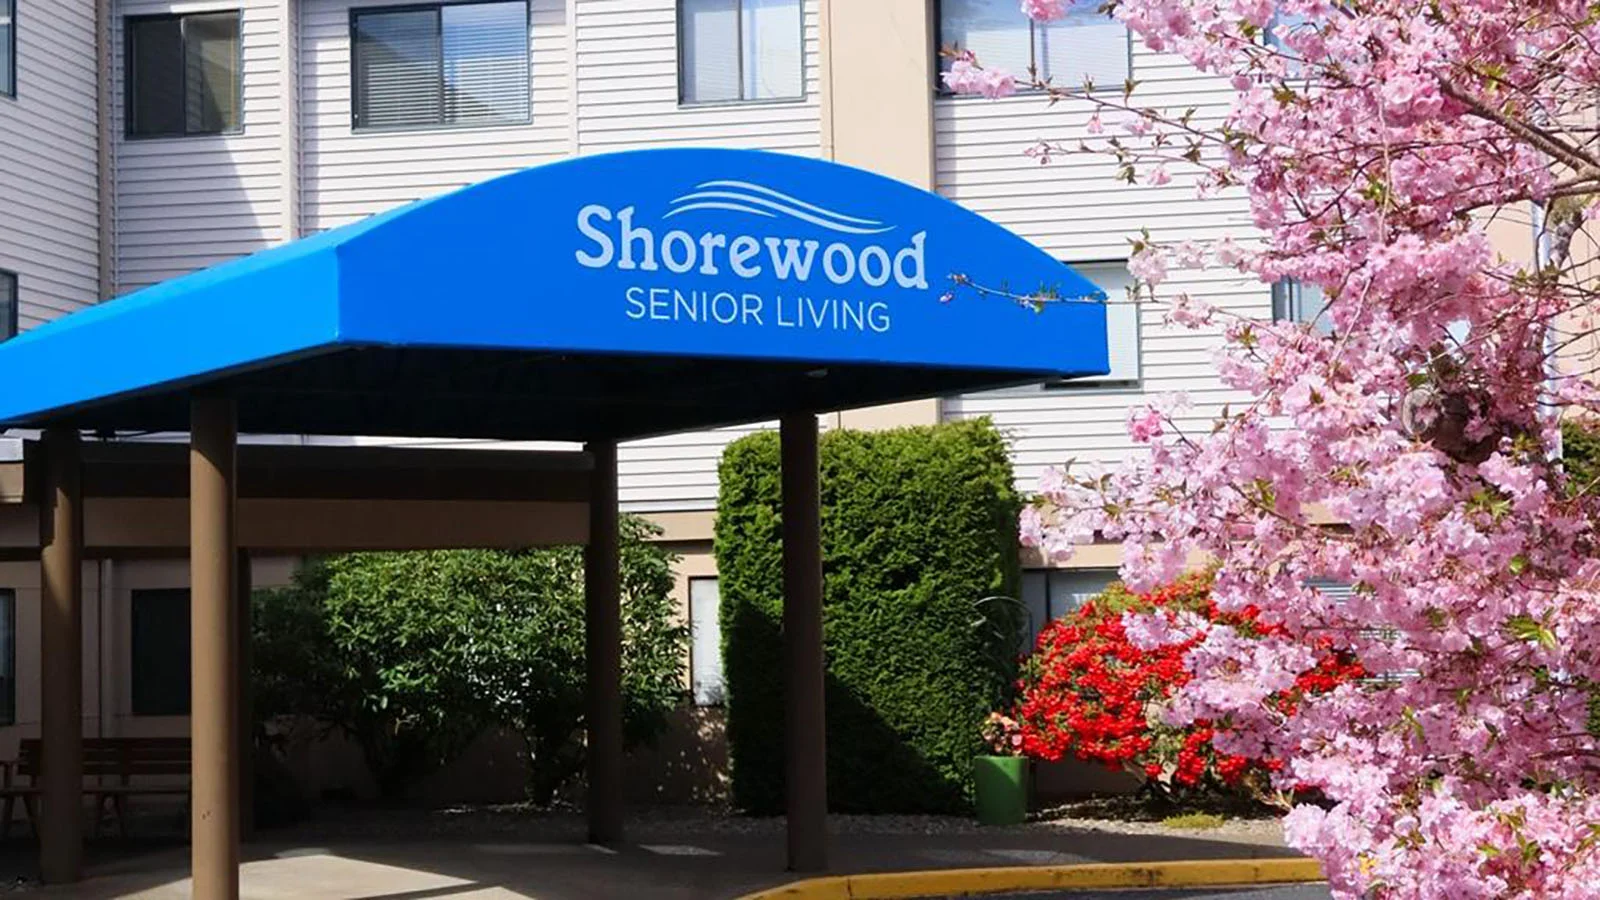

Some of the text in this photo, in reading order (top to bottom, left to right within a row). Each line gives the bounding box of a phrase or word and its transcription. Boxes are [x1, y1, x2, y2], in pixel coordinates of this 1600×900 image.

[576, 204, 929, 290] Shorewood
[625, 287, 890, 333] SENIOR LIVING
